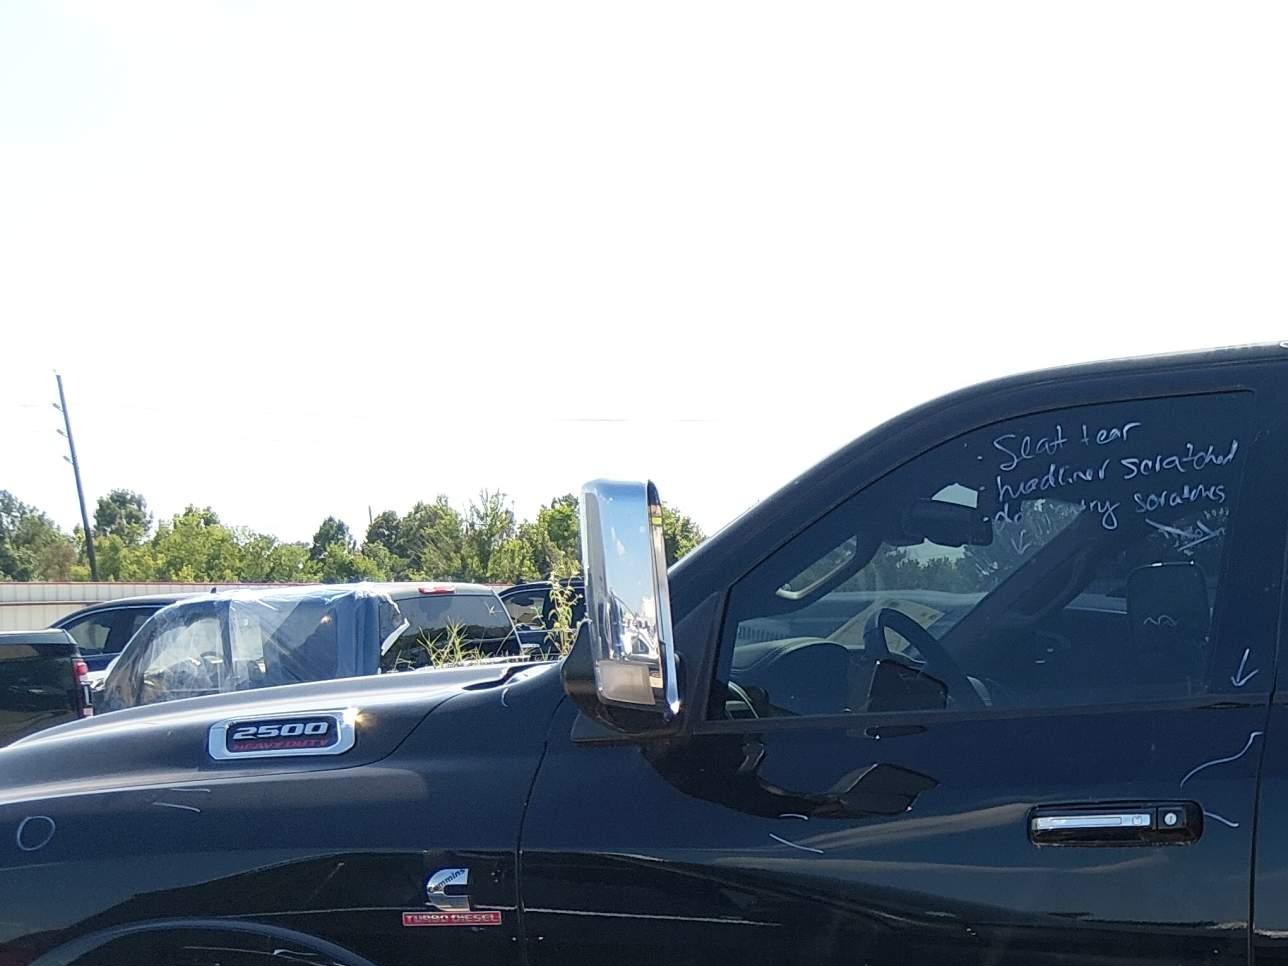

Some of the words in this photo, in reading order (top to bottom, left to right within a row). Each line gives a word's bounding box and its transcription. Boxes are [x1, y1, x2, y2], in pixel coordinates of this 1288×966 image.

[1081, 421, 1142, 446] tear
[233, 721, 329, 740] 2500
[405, 914, 449, 923] TURBO
[451, 914, 499, 923] DIESEL
